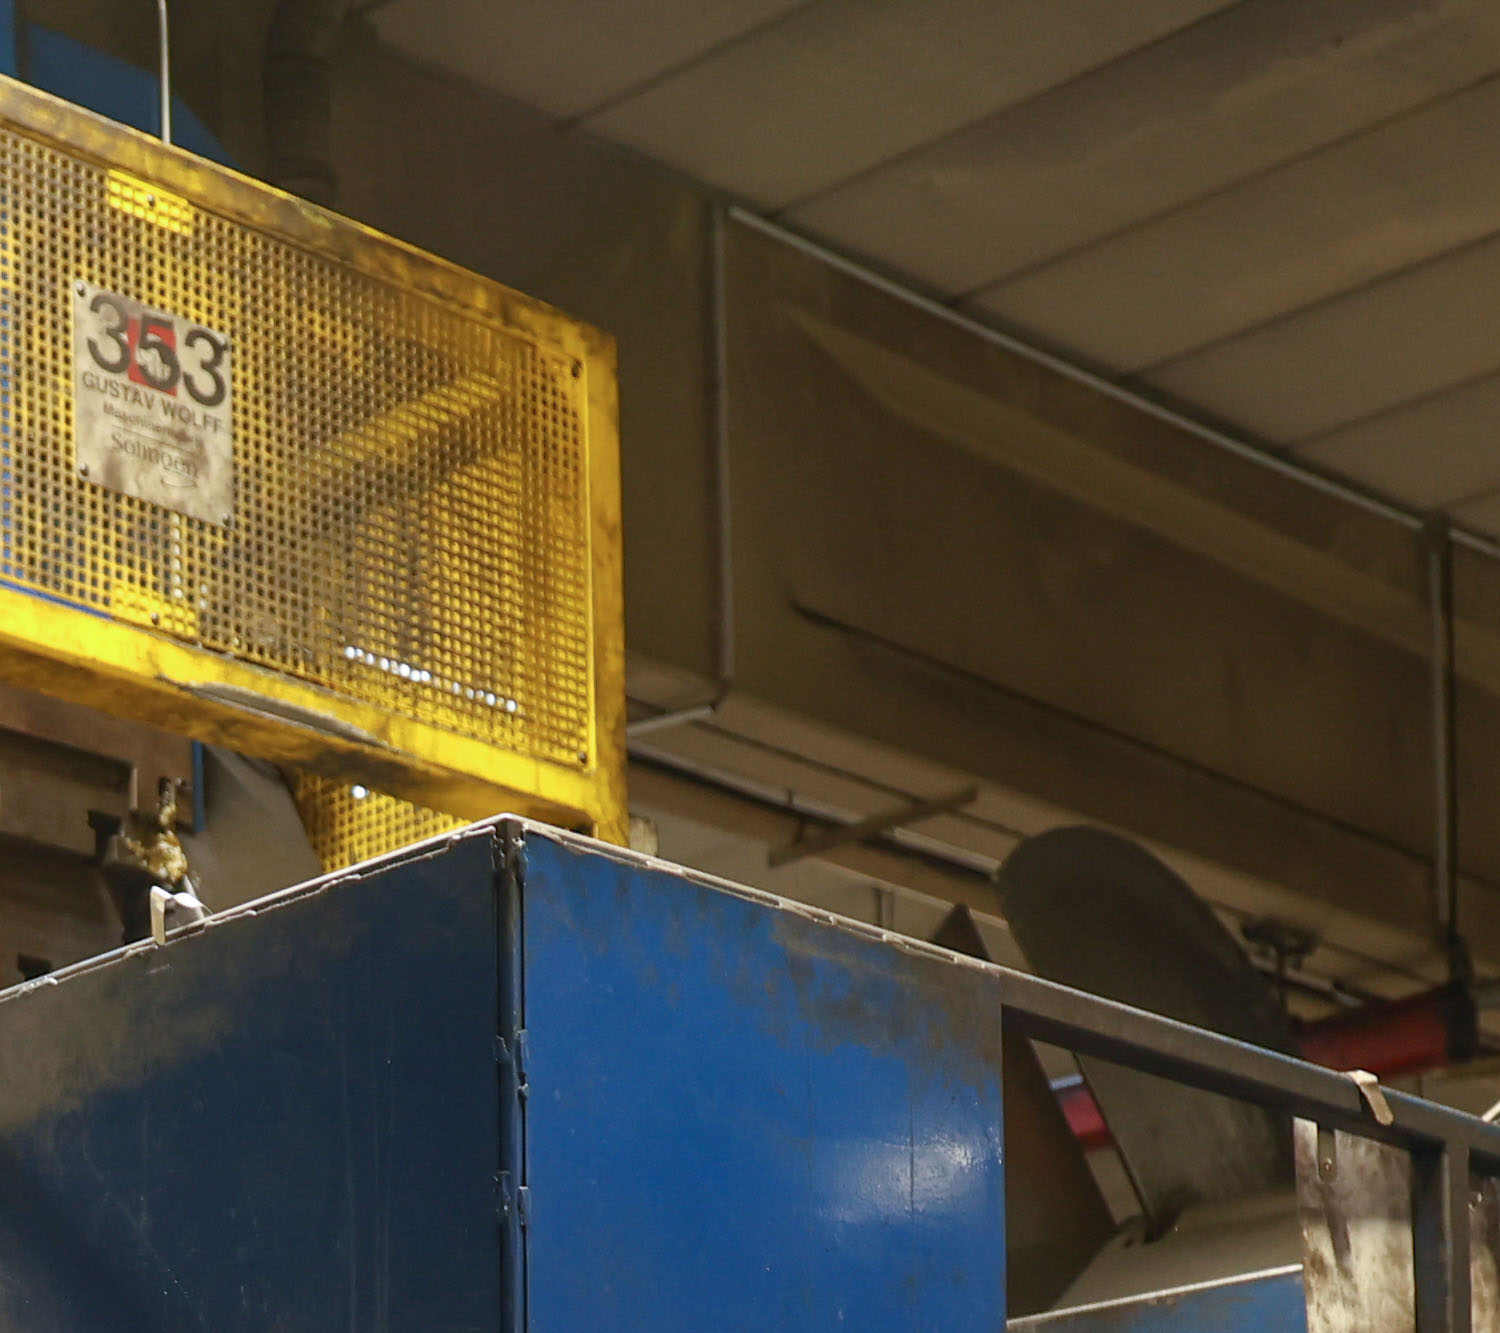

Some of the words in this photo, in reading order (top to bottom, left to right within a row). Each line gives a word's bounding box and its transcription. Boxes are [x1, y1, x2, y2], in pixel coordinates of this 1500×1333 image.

[87, 294, 226, 407] 353
[82, 371, 155, 410] GUSTAV
[161, 398, 223, 433] WOLFF
